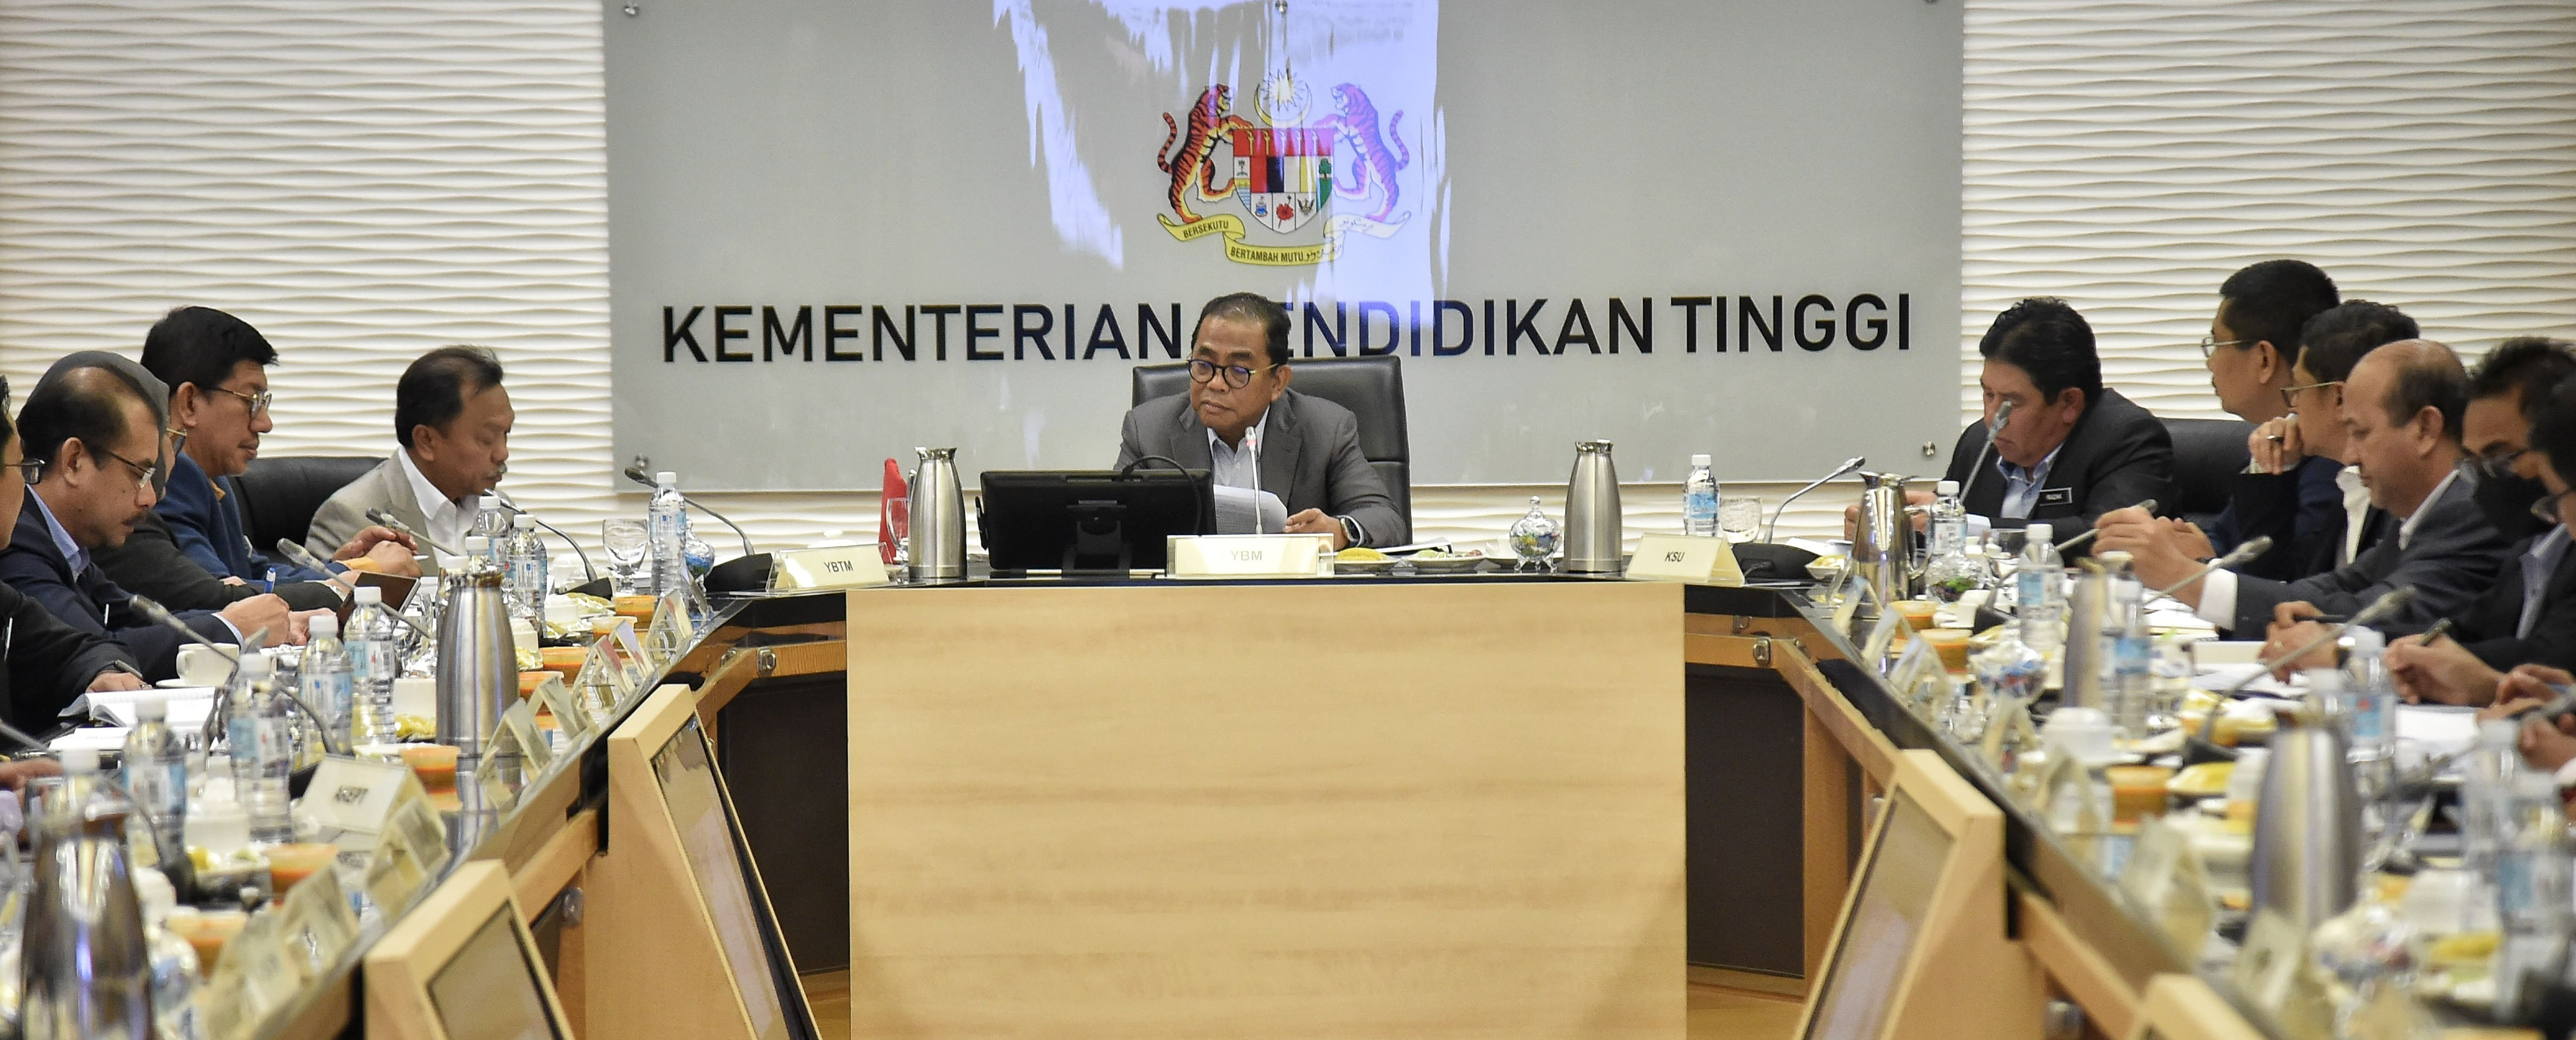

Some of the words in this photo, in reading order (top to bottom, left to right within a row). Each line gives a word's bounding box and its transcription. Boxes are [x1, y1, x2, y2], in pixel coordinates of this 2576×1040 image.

[1183, 220, 1229, 239] BERSEKUTU
[1231, 247, 1279, 261] BERTAMBAH
[1281, 251, 1303, 262] MUTU
[663, 303, 1182, 363] KEMENTERIAN
[1283, 297, 1653, 358] NDIDIKAN
[1671, 292, 1910, 354] TINGGI
[1230, 550, 1263, 561] YBM
[1665, 551, 1685, 562] KSU
[824, 560, 854, 573] YBTM
